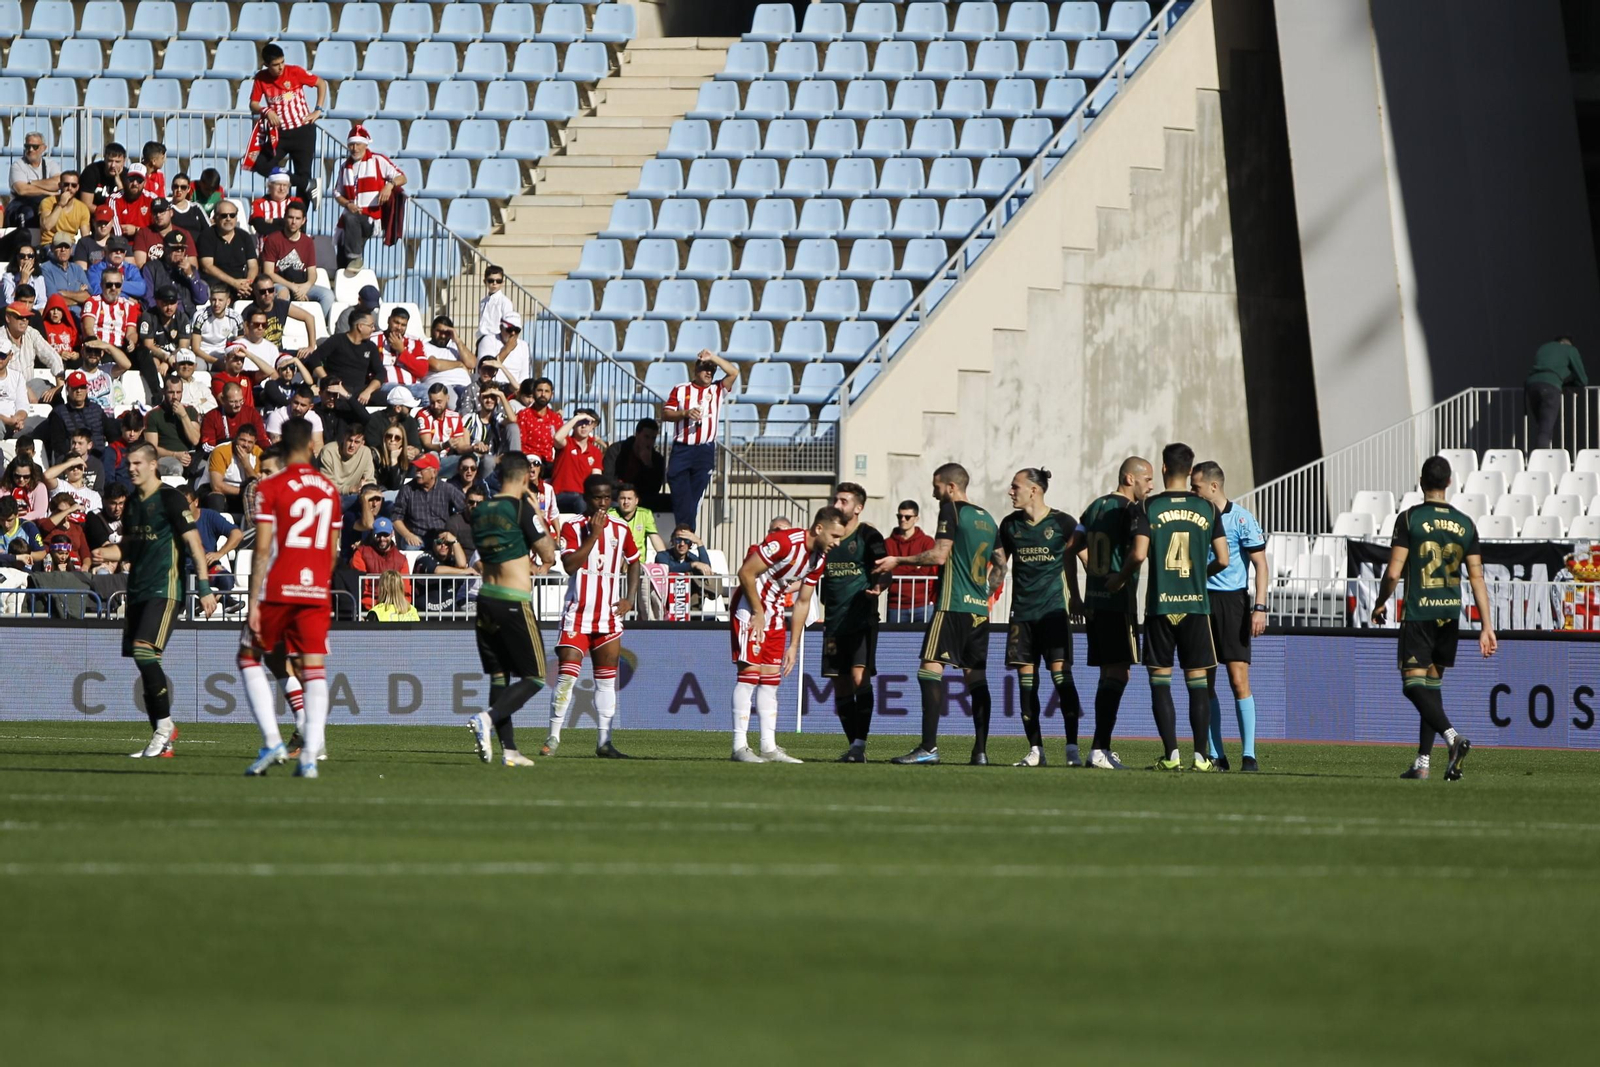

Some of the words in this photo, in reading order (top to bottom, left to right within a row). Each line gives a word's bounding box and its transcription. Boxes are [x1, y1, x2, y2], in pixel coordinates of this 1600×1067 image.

[284, 497, 334, 550] 21
[1157, 509, 1210, 531] TRIGUEROS
[1422, 522, 1434, 534] F.
[1434, 519, 1466, 537] RUSSO
[972, 541, 989, 586] 6
[1016, 546, 1050, 555] HERRERO
[1020, 554, 1056, 563] GANTINA
[1165, 531, 1191, 578] 4
[1419, 540, 1464, 589] 22
[387, 673, 484, 715] DE
[1490, 683, 1595, 730] COS
